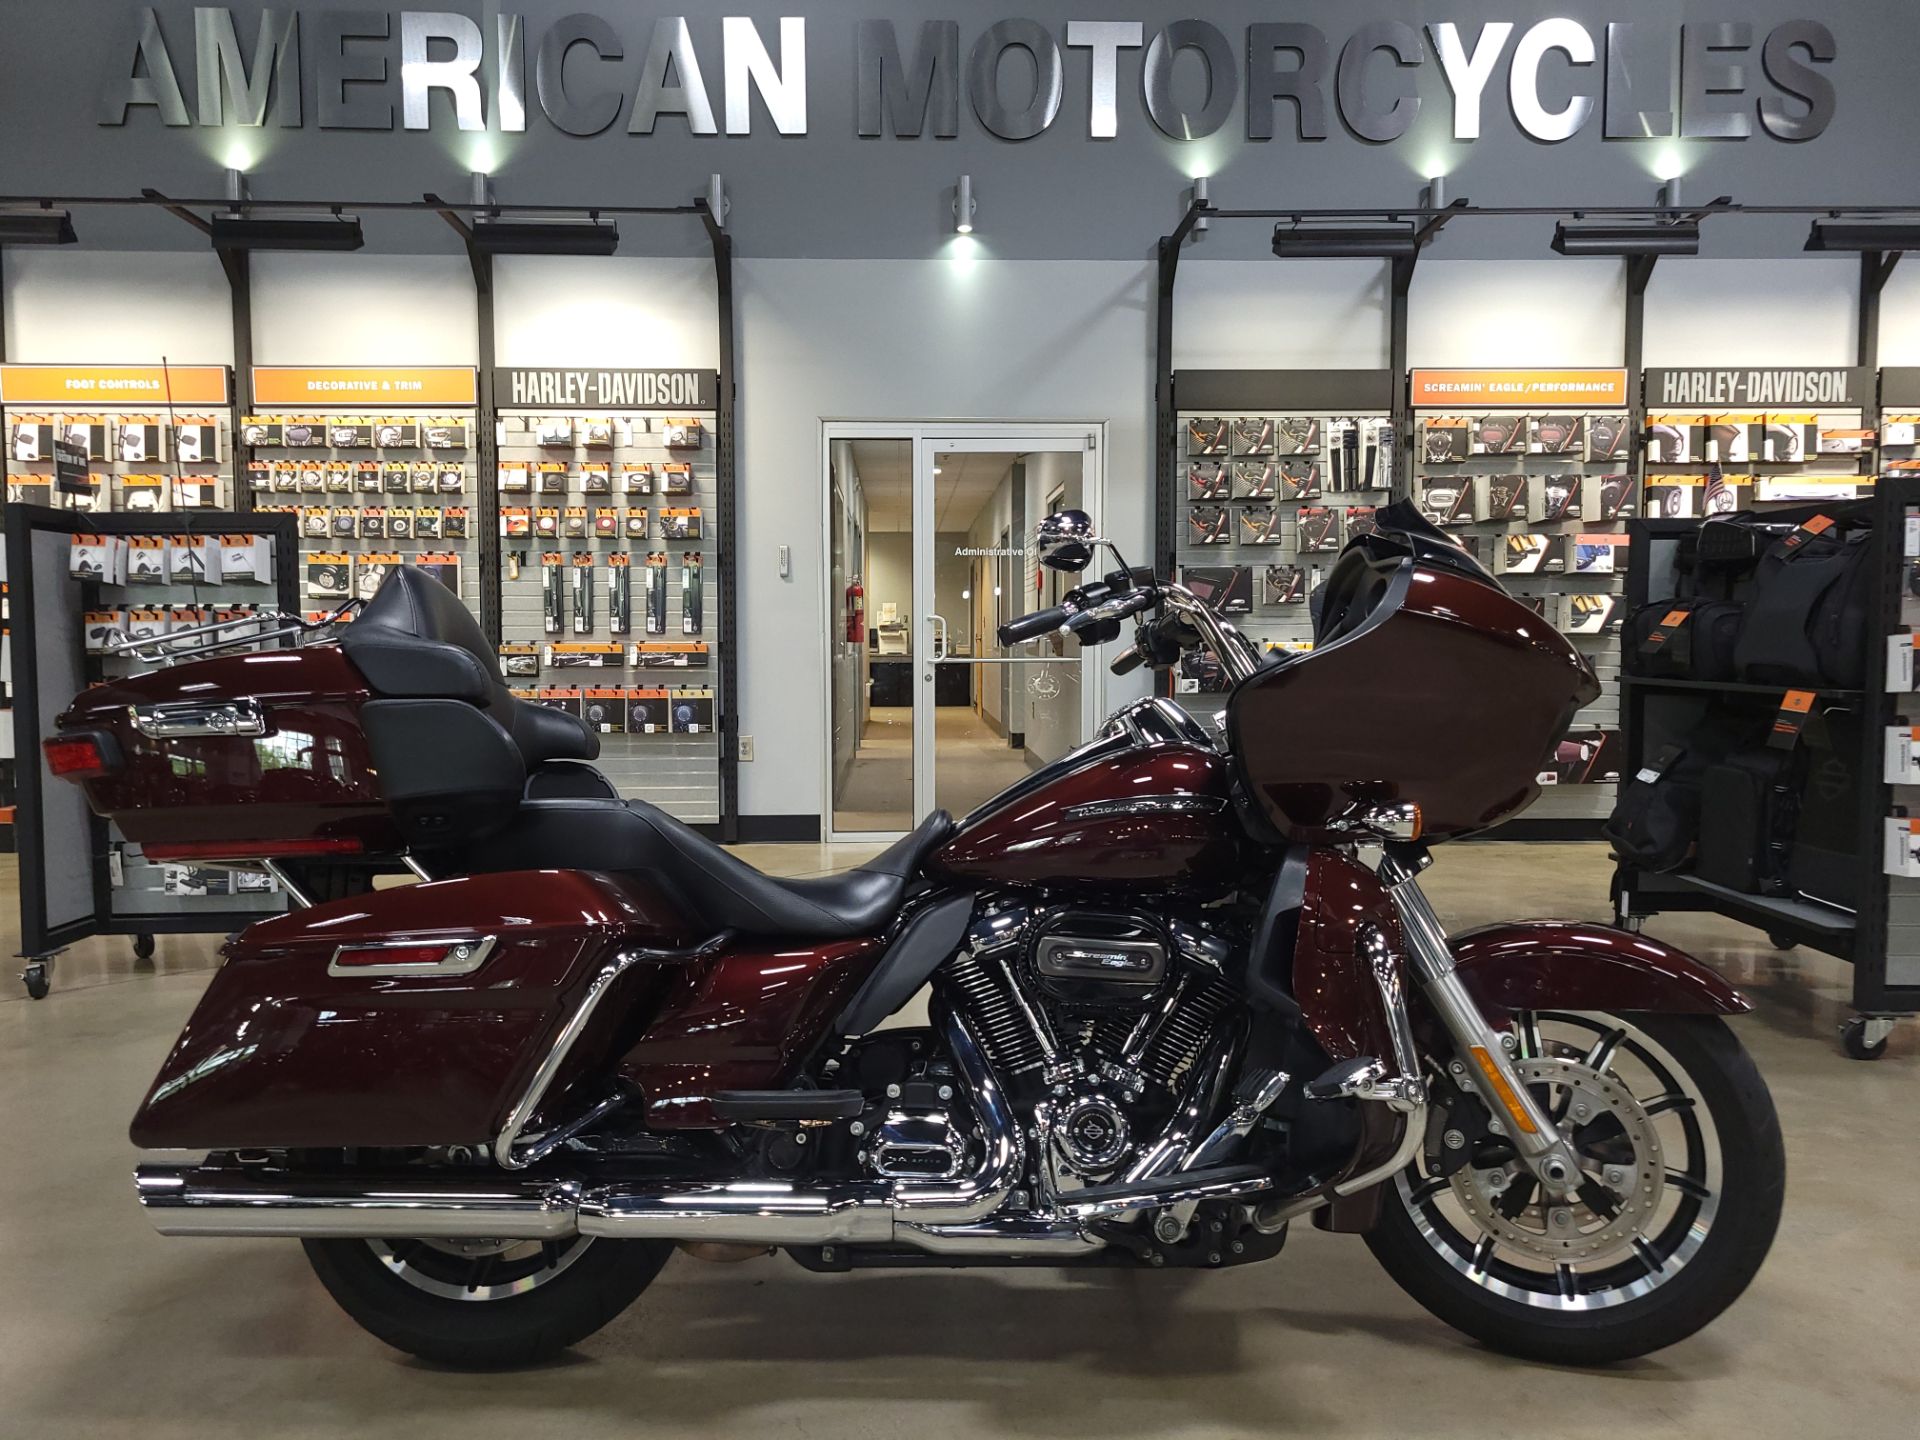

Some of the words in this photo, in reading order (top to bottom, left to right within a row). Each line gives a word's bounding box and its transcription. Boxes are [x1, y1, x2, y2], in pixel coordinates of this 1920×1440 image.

[98, 7, 807, 136] AMERICAN
[856, 17, 1838, 142] MOTORCYCLES
[65, 379, 95, 389] FOOT
[98, 379, 160, 390] CONTROLS
[307, 380, 378, 390] DECORATIVE
[382, 380, 390, 390] &
[394, 380, 422, 390] TRIM
[511, 371, 699, 405] HARLEY-DAVIDSON
[1424, 383, 1485, 392] SCREAMIN'
[1663, 371, 1847, 403] HARLEY-DAVIDSON
[955, 547, 1023, 556] Administrative
[1101, 958, 1136, 968] Eagle
